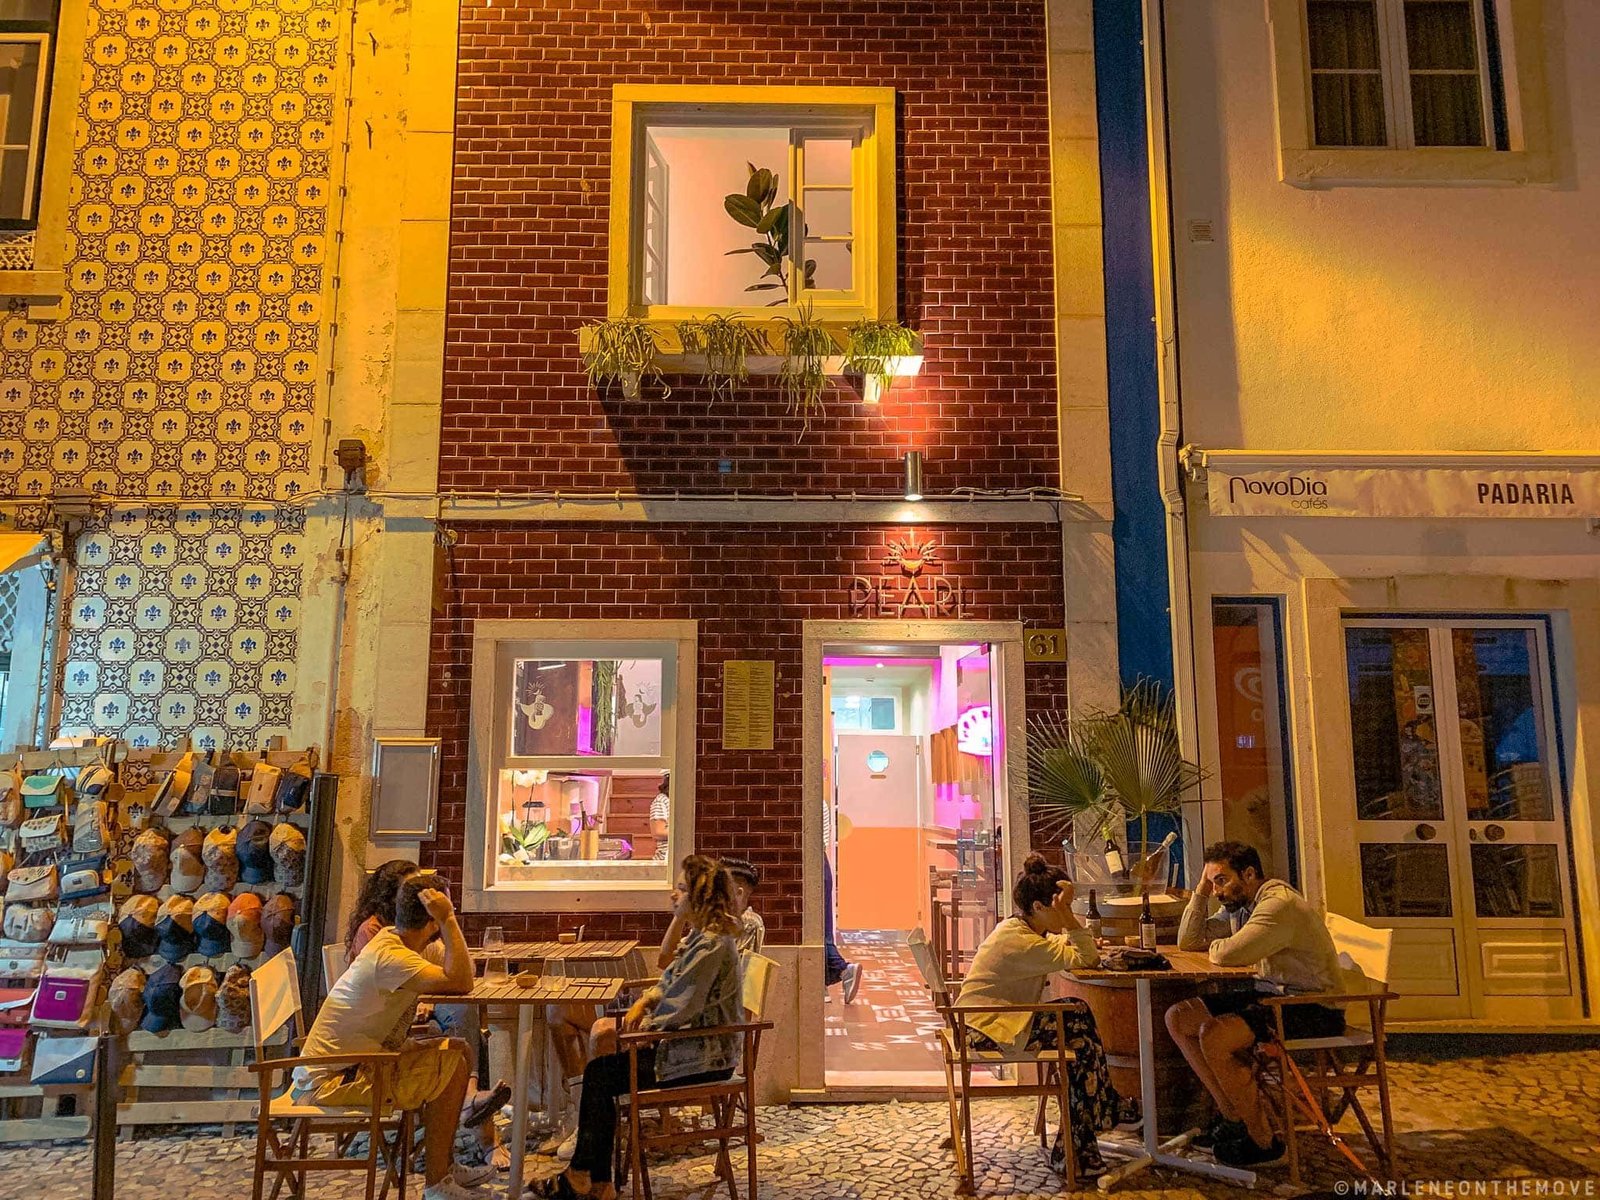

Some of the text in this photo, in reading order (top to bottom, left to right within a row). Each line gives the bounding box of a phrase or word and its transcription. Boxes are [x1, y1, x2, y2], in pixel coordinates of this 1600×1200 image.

[1290, 497, 1329, 509] cafés
[1477, 483, 1575, 504] PADARIA
[849, 576, 975, 618] PEARL
[1028, 634, 1058, 656] 61
